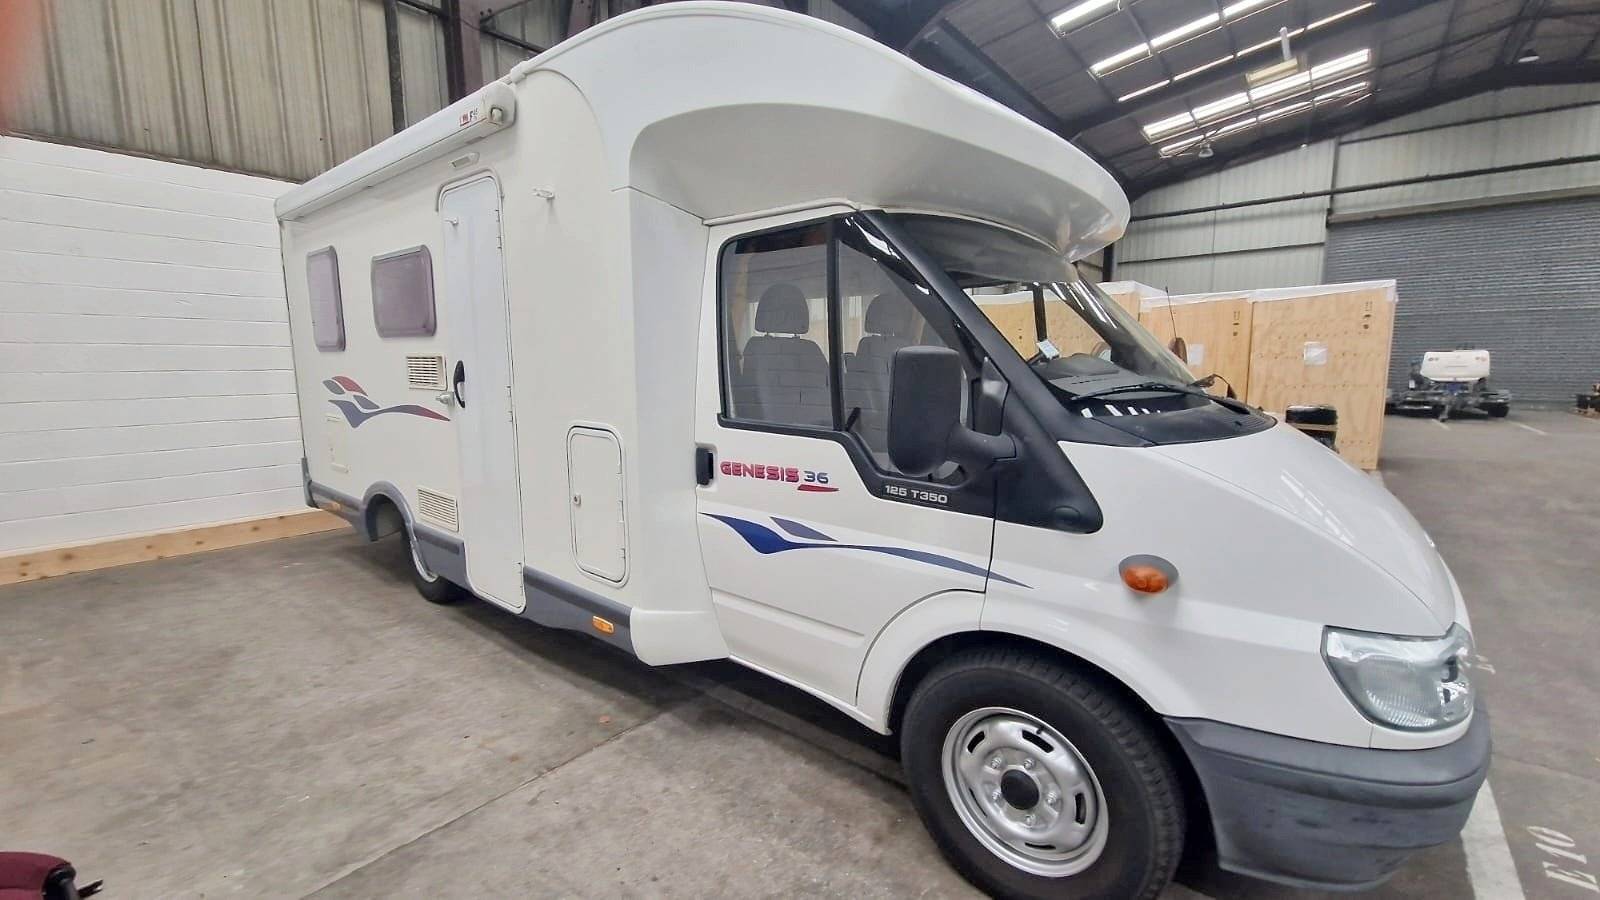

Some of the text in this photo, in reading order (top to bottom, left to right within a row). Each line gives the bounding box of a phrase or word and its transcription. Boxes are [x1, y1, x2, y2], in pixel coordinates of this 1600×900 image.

[720, 461, 829, 484] GENESIS 36
[885, 485, 948, 504] 125 T350
